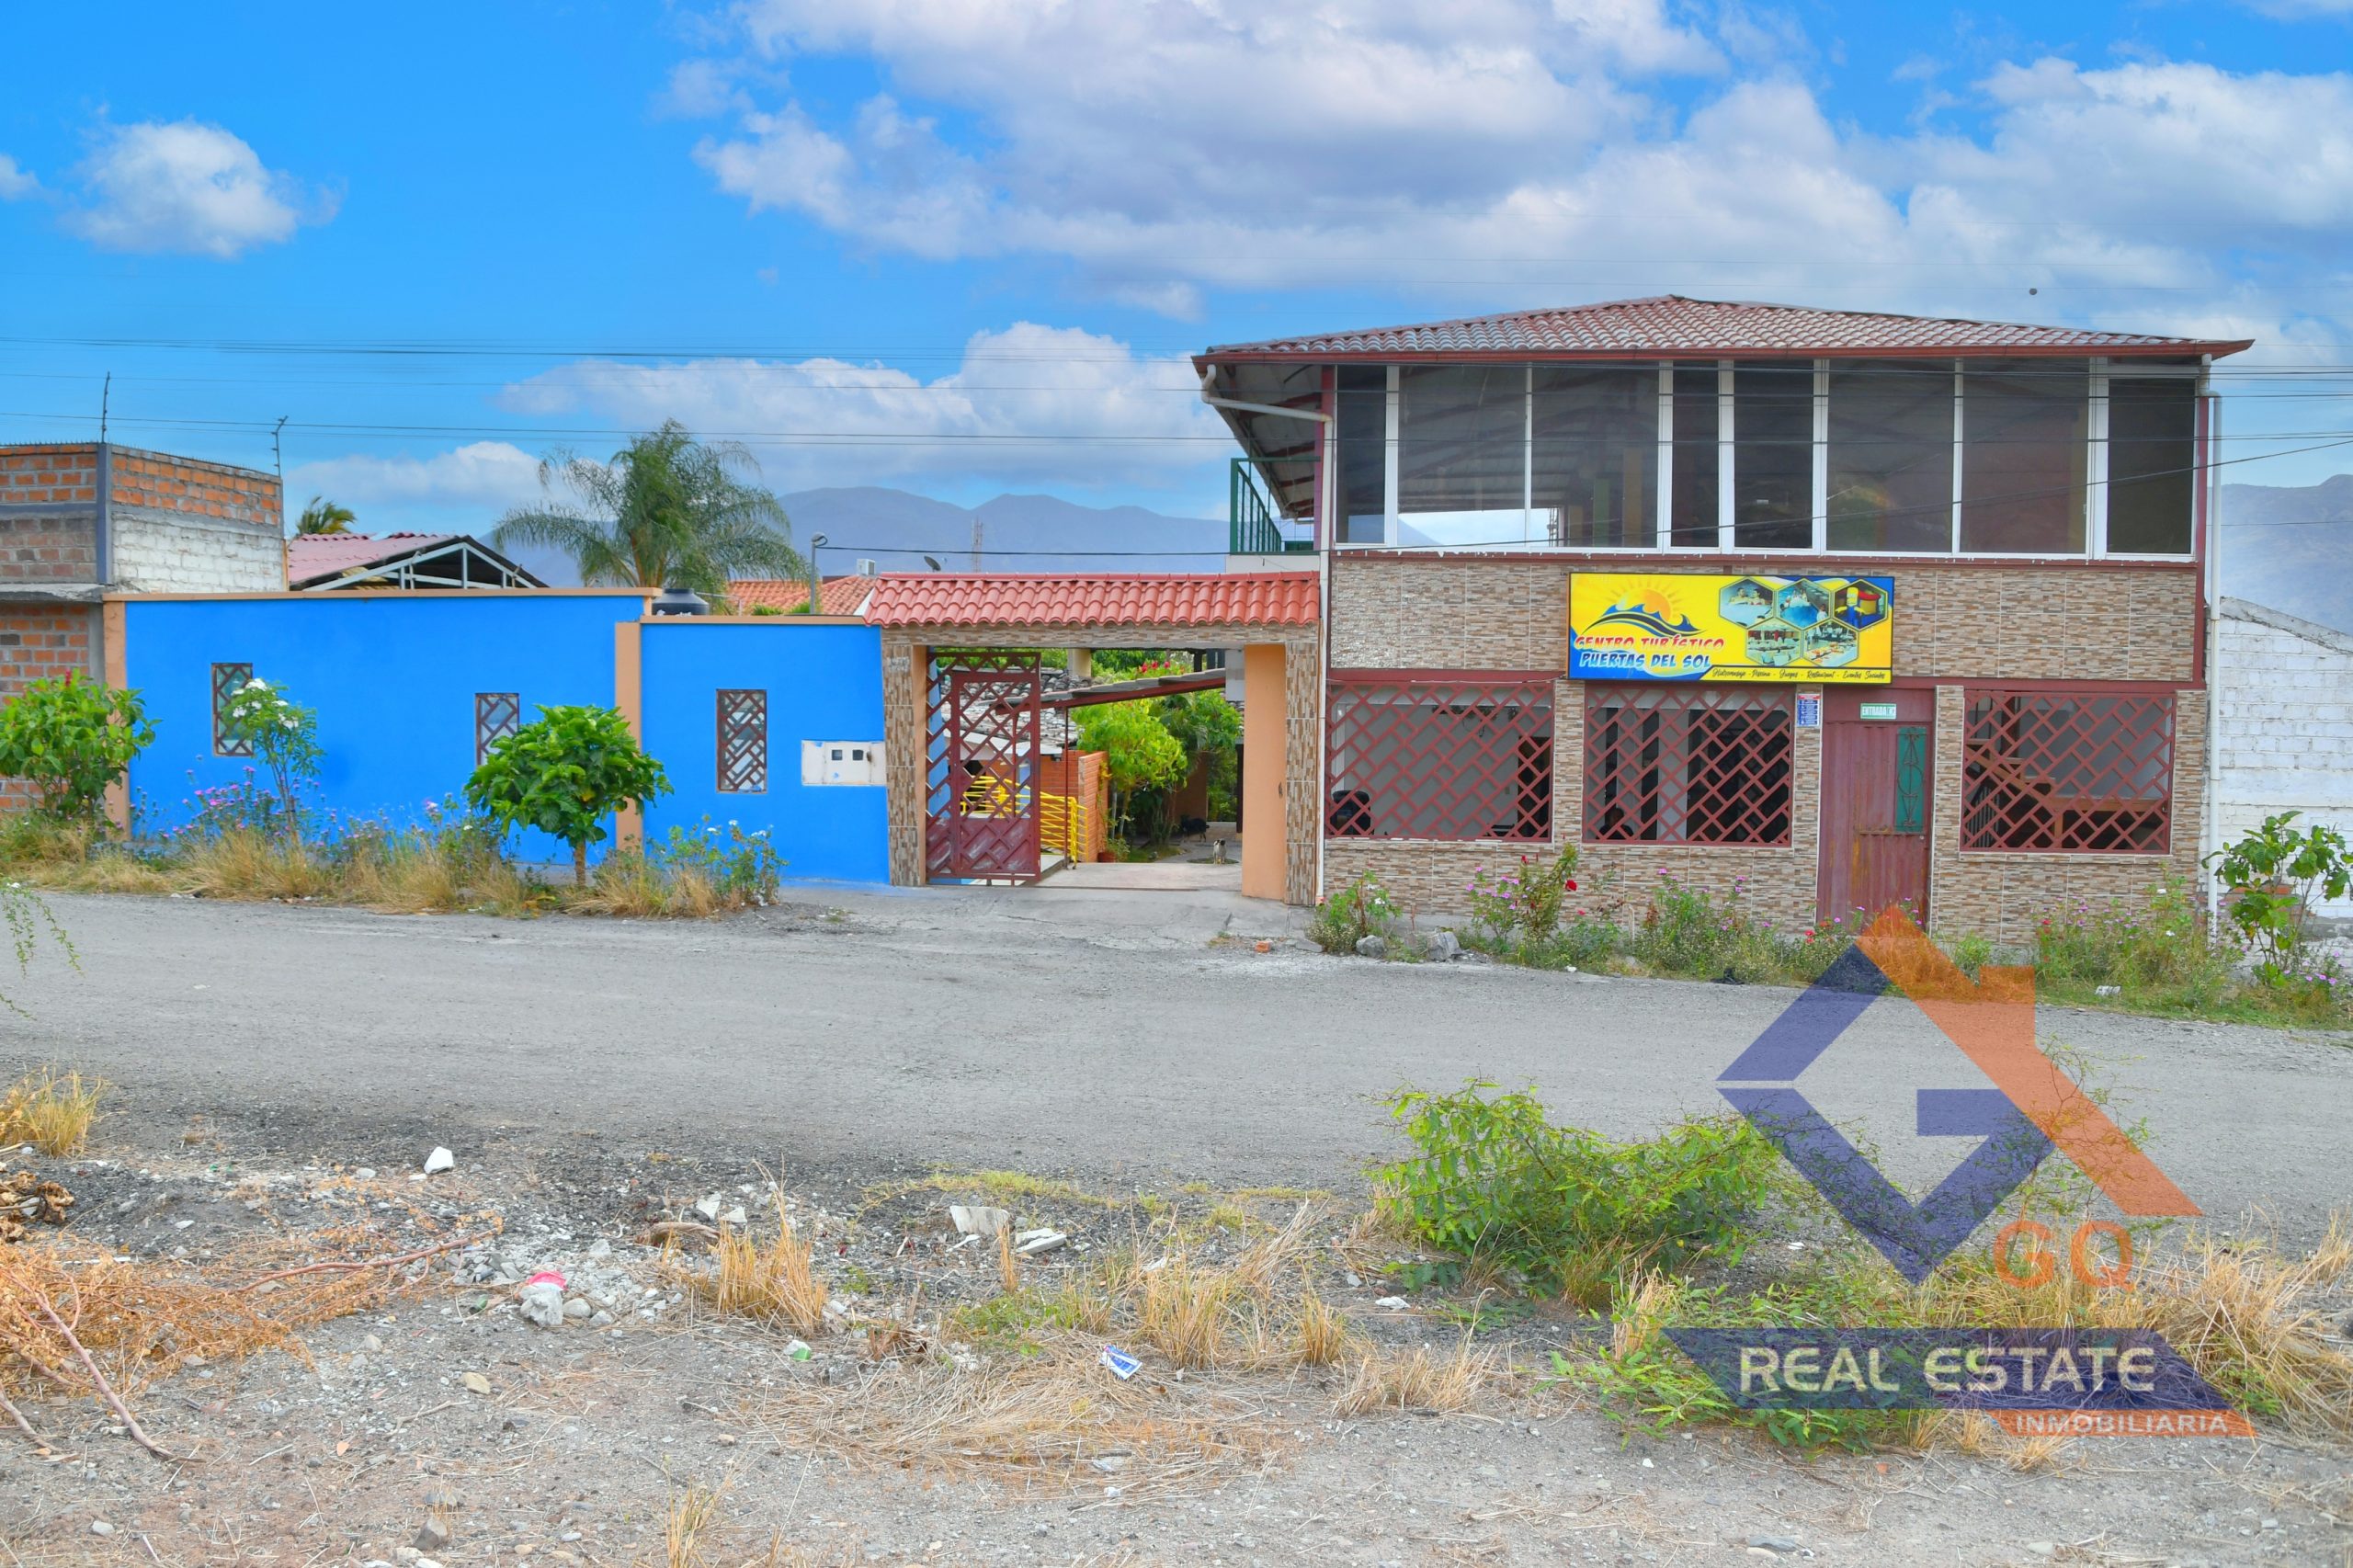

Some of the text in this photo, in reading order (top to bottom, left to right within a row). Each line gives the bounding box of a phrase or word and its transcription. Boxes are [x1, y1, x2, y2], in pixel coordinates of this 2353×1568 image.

[1574, 636, 1635, 649] CENTRO
[1579, 653, 1711, 668] PUERTAS DEL SOL
